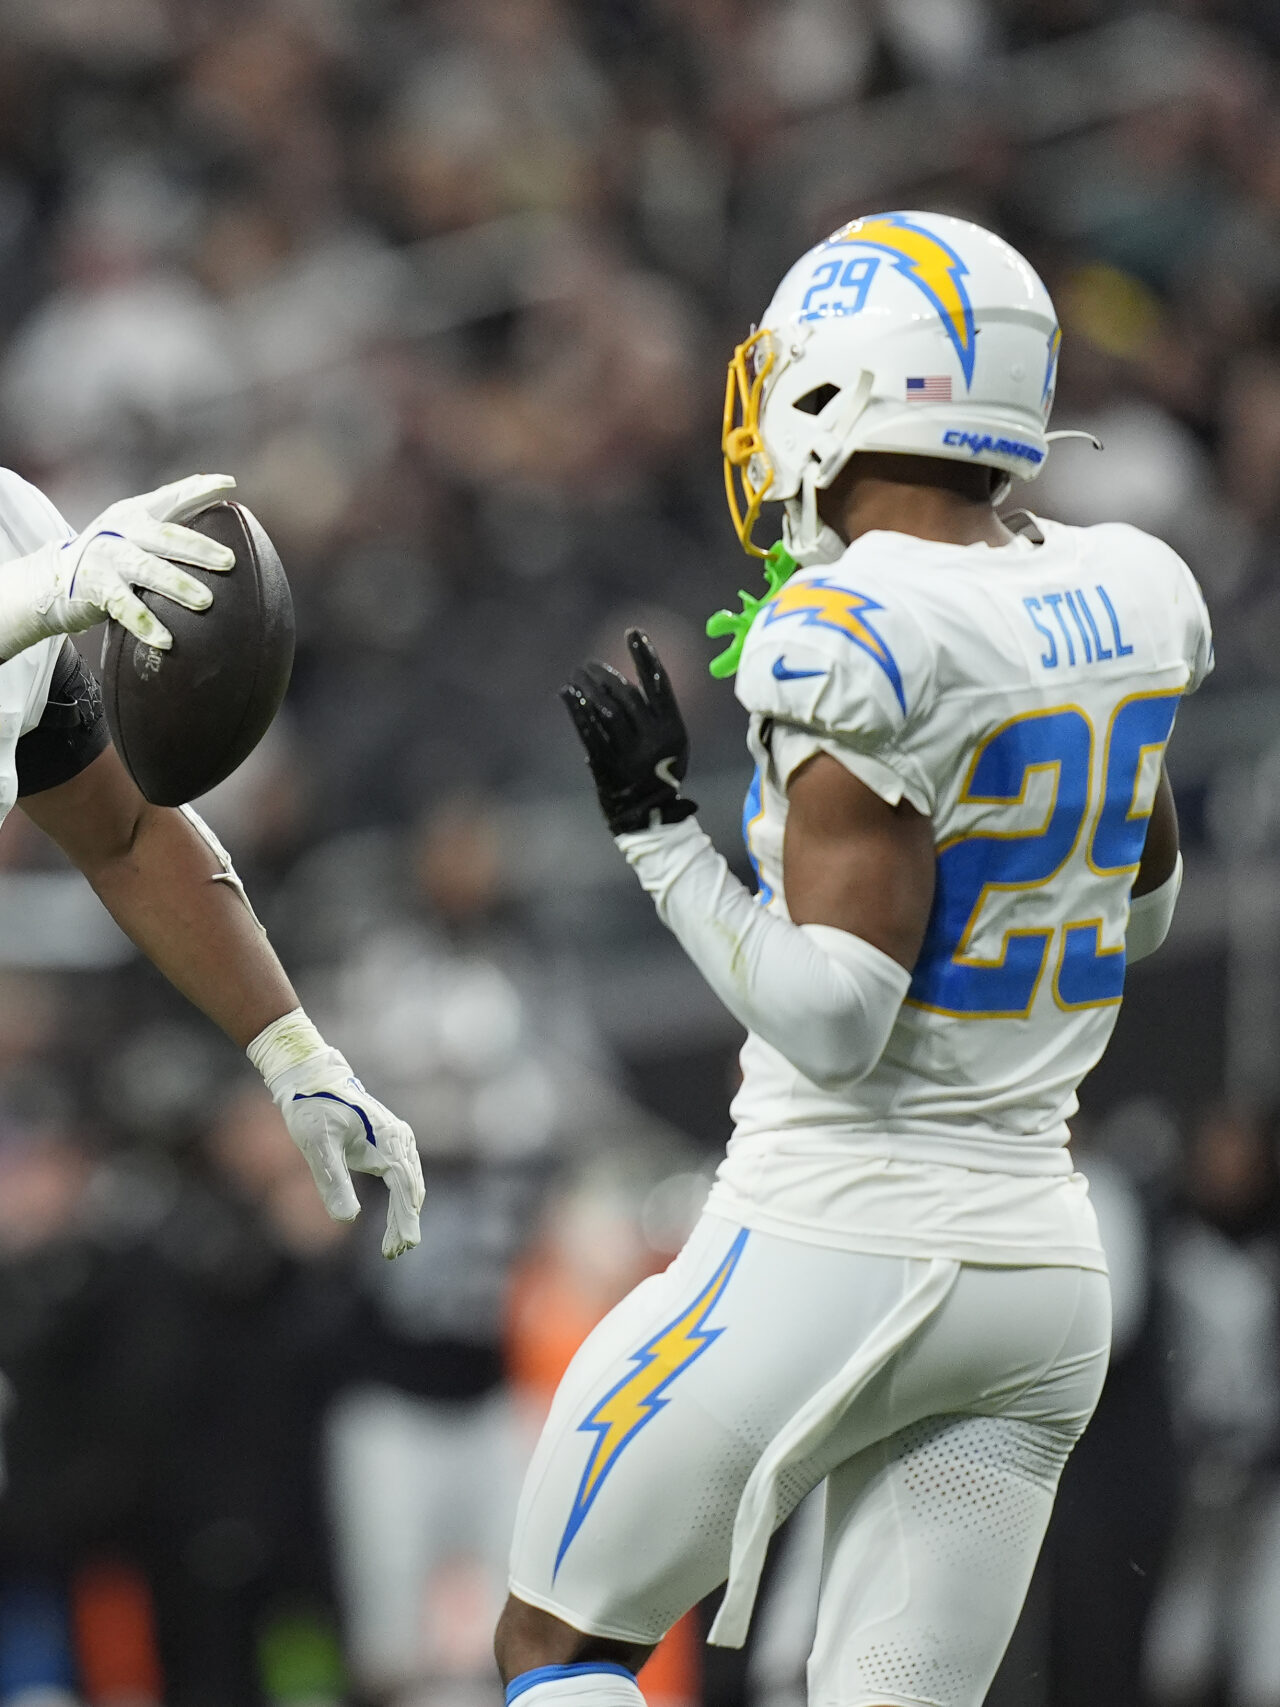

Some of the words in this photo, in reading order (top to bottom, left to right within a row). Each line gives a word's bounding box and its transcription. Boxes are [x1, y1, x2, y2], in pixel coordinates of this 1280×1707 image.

[799, 257, 881, 324] 29
[1022, 585, 1133, 668] STILL
[905, 685, 1186, 1019] 29
